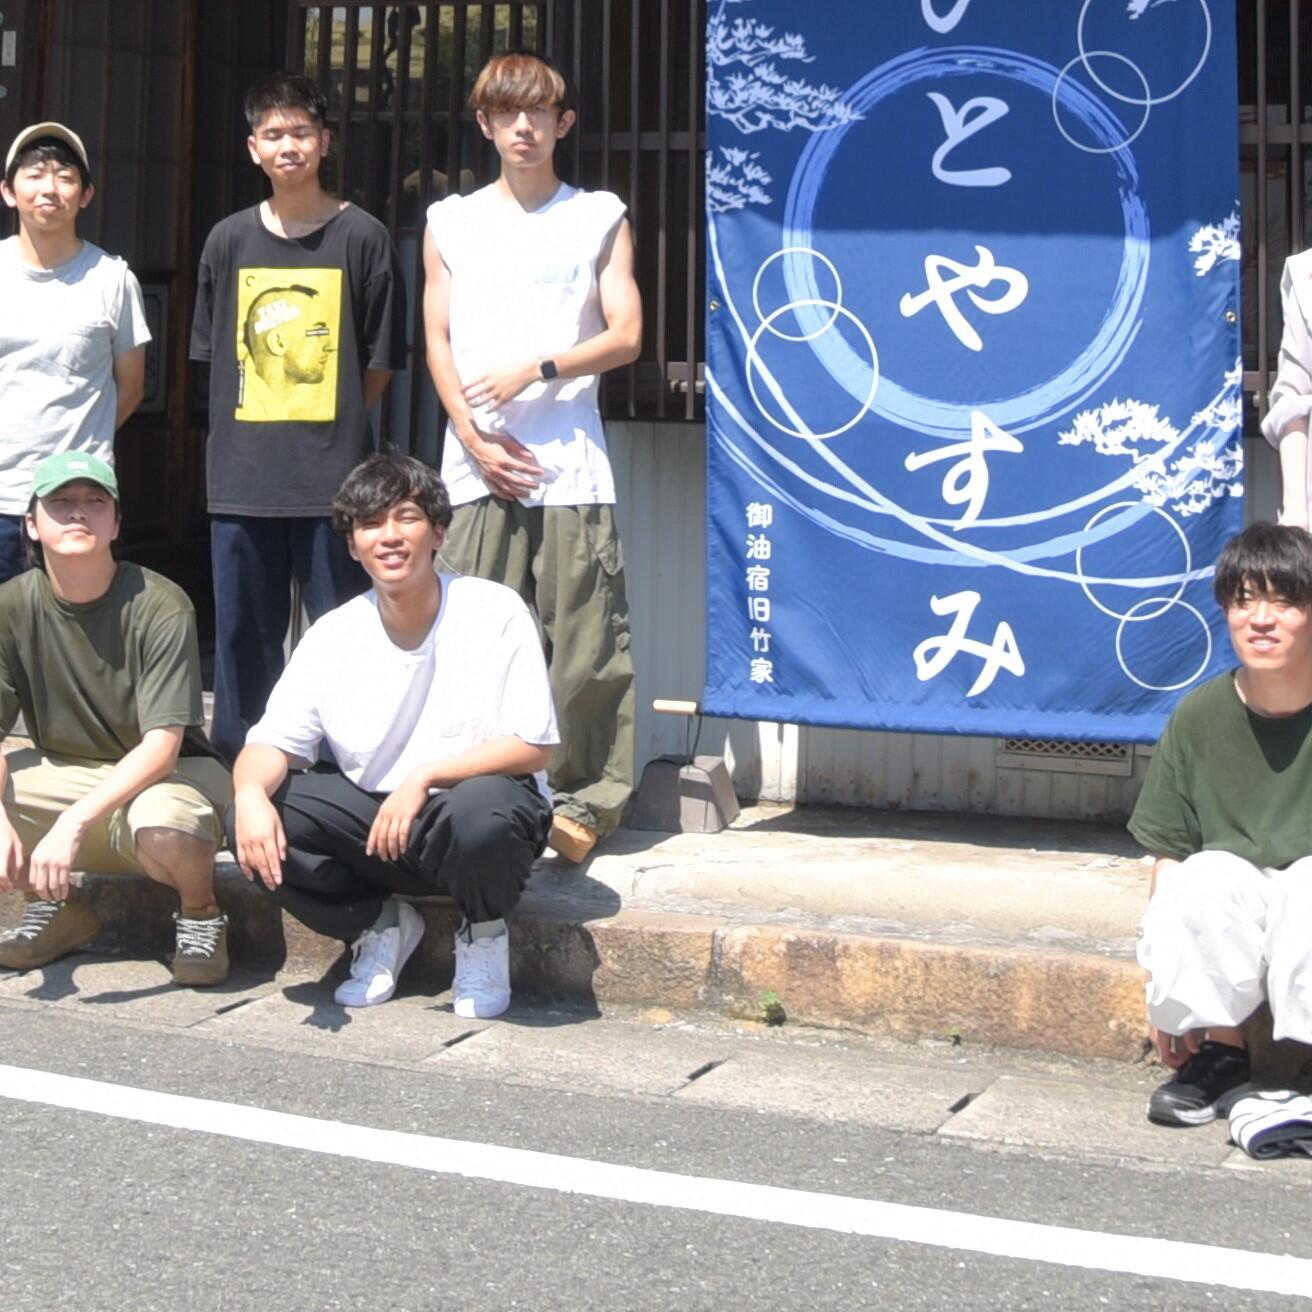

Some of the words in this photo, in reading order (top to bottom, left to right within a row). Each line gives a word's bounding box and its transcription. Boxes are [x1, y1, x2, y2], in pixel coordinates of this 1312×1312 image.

[745, 502, 774, 685] 御油宿旧竹家
